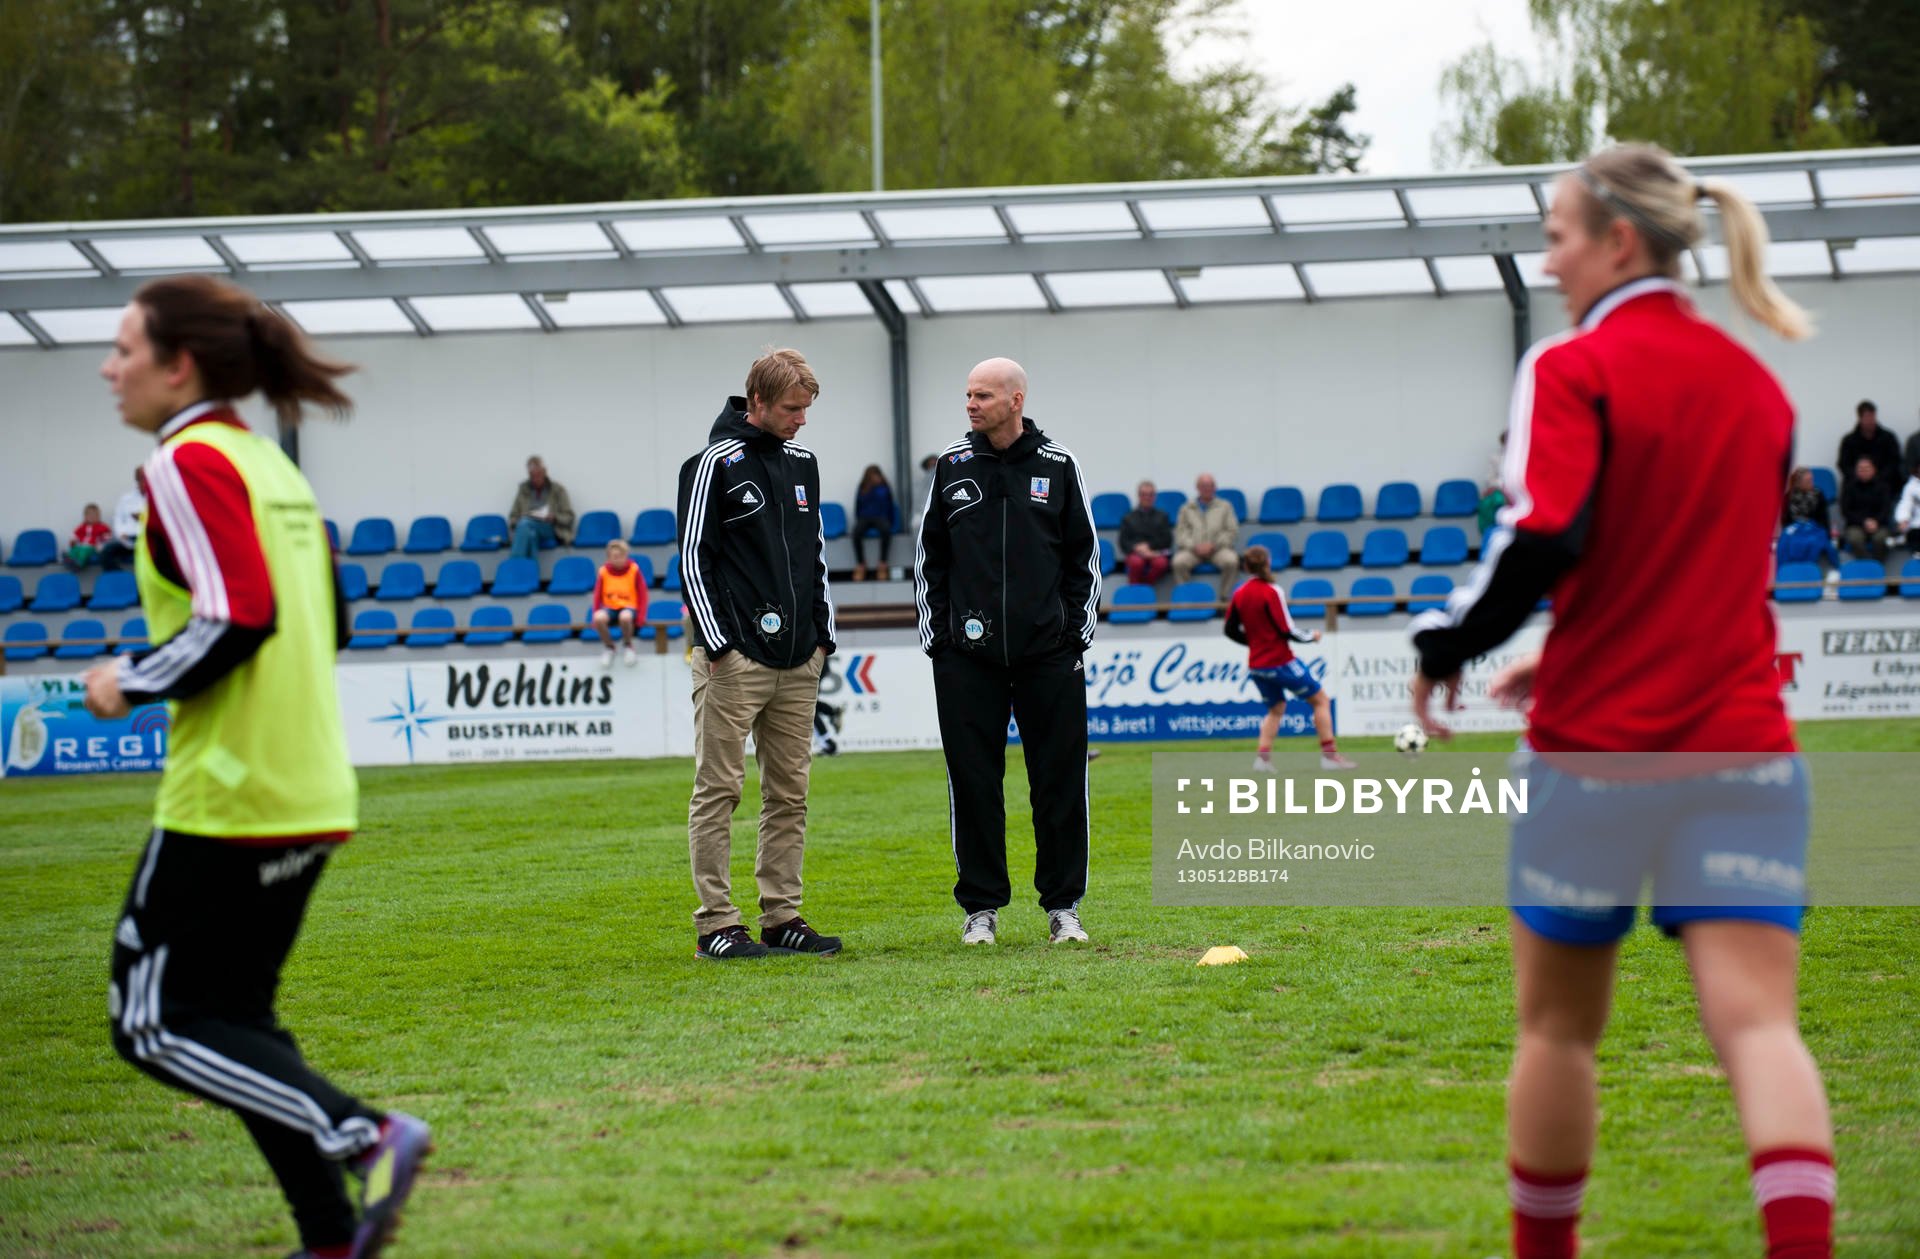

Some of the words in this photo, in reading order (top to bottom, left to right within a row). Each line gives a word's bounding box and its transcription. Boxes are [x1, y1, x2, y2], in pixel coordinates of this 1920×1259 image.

[762, 616, 780, 627] SFA
[966, 624, 982, 633] SFA
[1149, 643, 1328, 693] Campg
[447, 661, 613, 708] Wehlins
[448, 722, 578, 740] BUSSTRAFIK
[586, 721, 612, 735] AB
[1111, 713, 1155, 733] året!
[112, 757, 152, 769] Center
